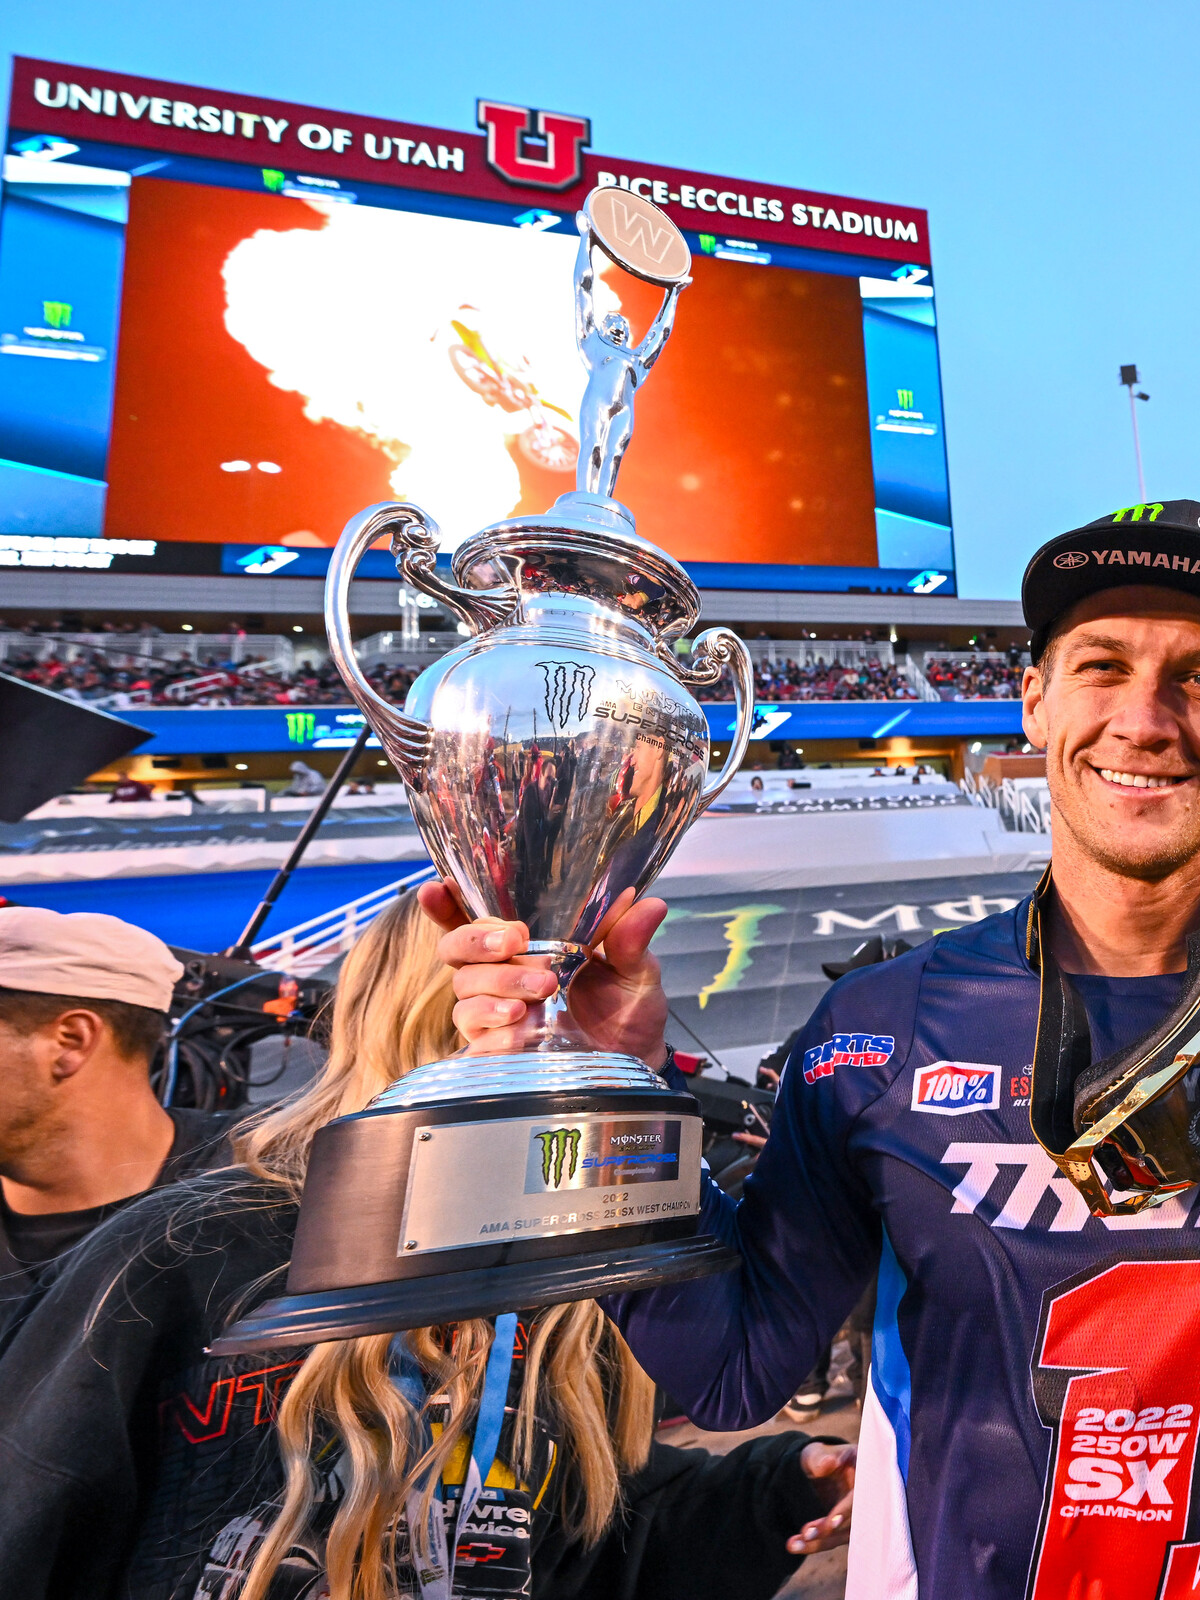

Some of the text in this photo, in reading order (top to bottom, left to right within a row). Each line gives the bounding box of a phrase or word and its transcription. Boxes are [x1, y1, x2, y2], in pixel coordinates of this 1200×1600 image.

[34, 78, 465, 172] UNIVERSITY OF UTAH
[477, 98, 591, 192] U
[597, 171, 919, 243] RICE-ECCLES STADIUM
[610, 197, 675, 265] W
[593, 706, 706, 761] SUPERCROSS
[803, 1033, 895, 1073] PARTS
[804, 1052, 889, 1085] UNITED
[924, 1073, 991, 1101] 100%
[610, 1133, 662, 1145] MONSTER
[602, 1192, 629, 1204] 2022
[479, 1221, 510, 1236] AMA
[514, 1211, 601, 1231] SUPERCROSS
[637, 1203, 660, 1215] WEST
[1074, 1403, 1193, 1433] 2022
[1071, 1432, 1188, 1457] 250W
[1064, 1456, 1179, 1505] SX
[1059, 1505, 1172, 1522] CHAMPION
